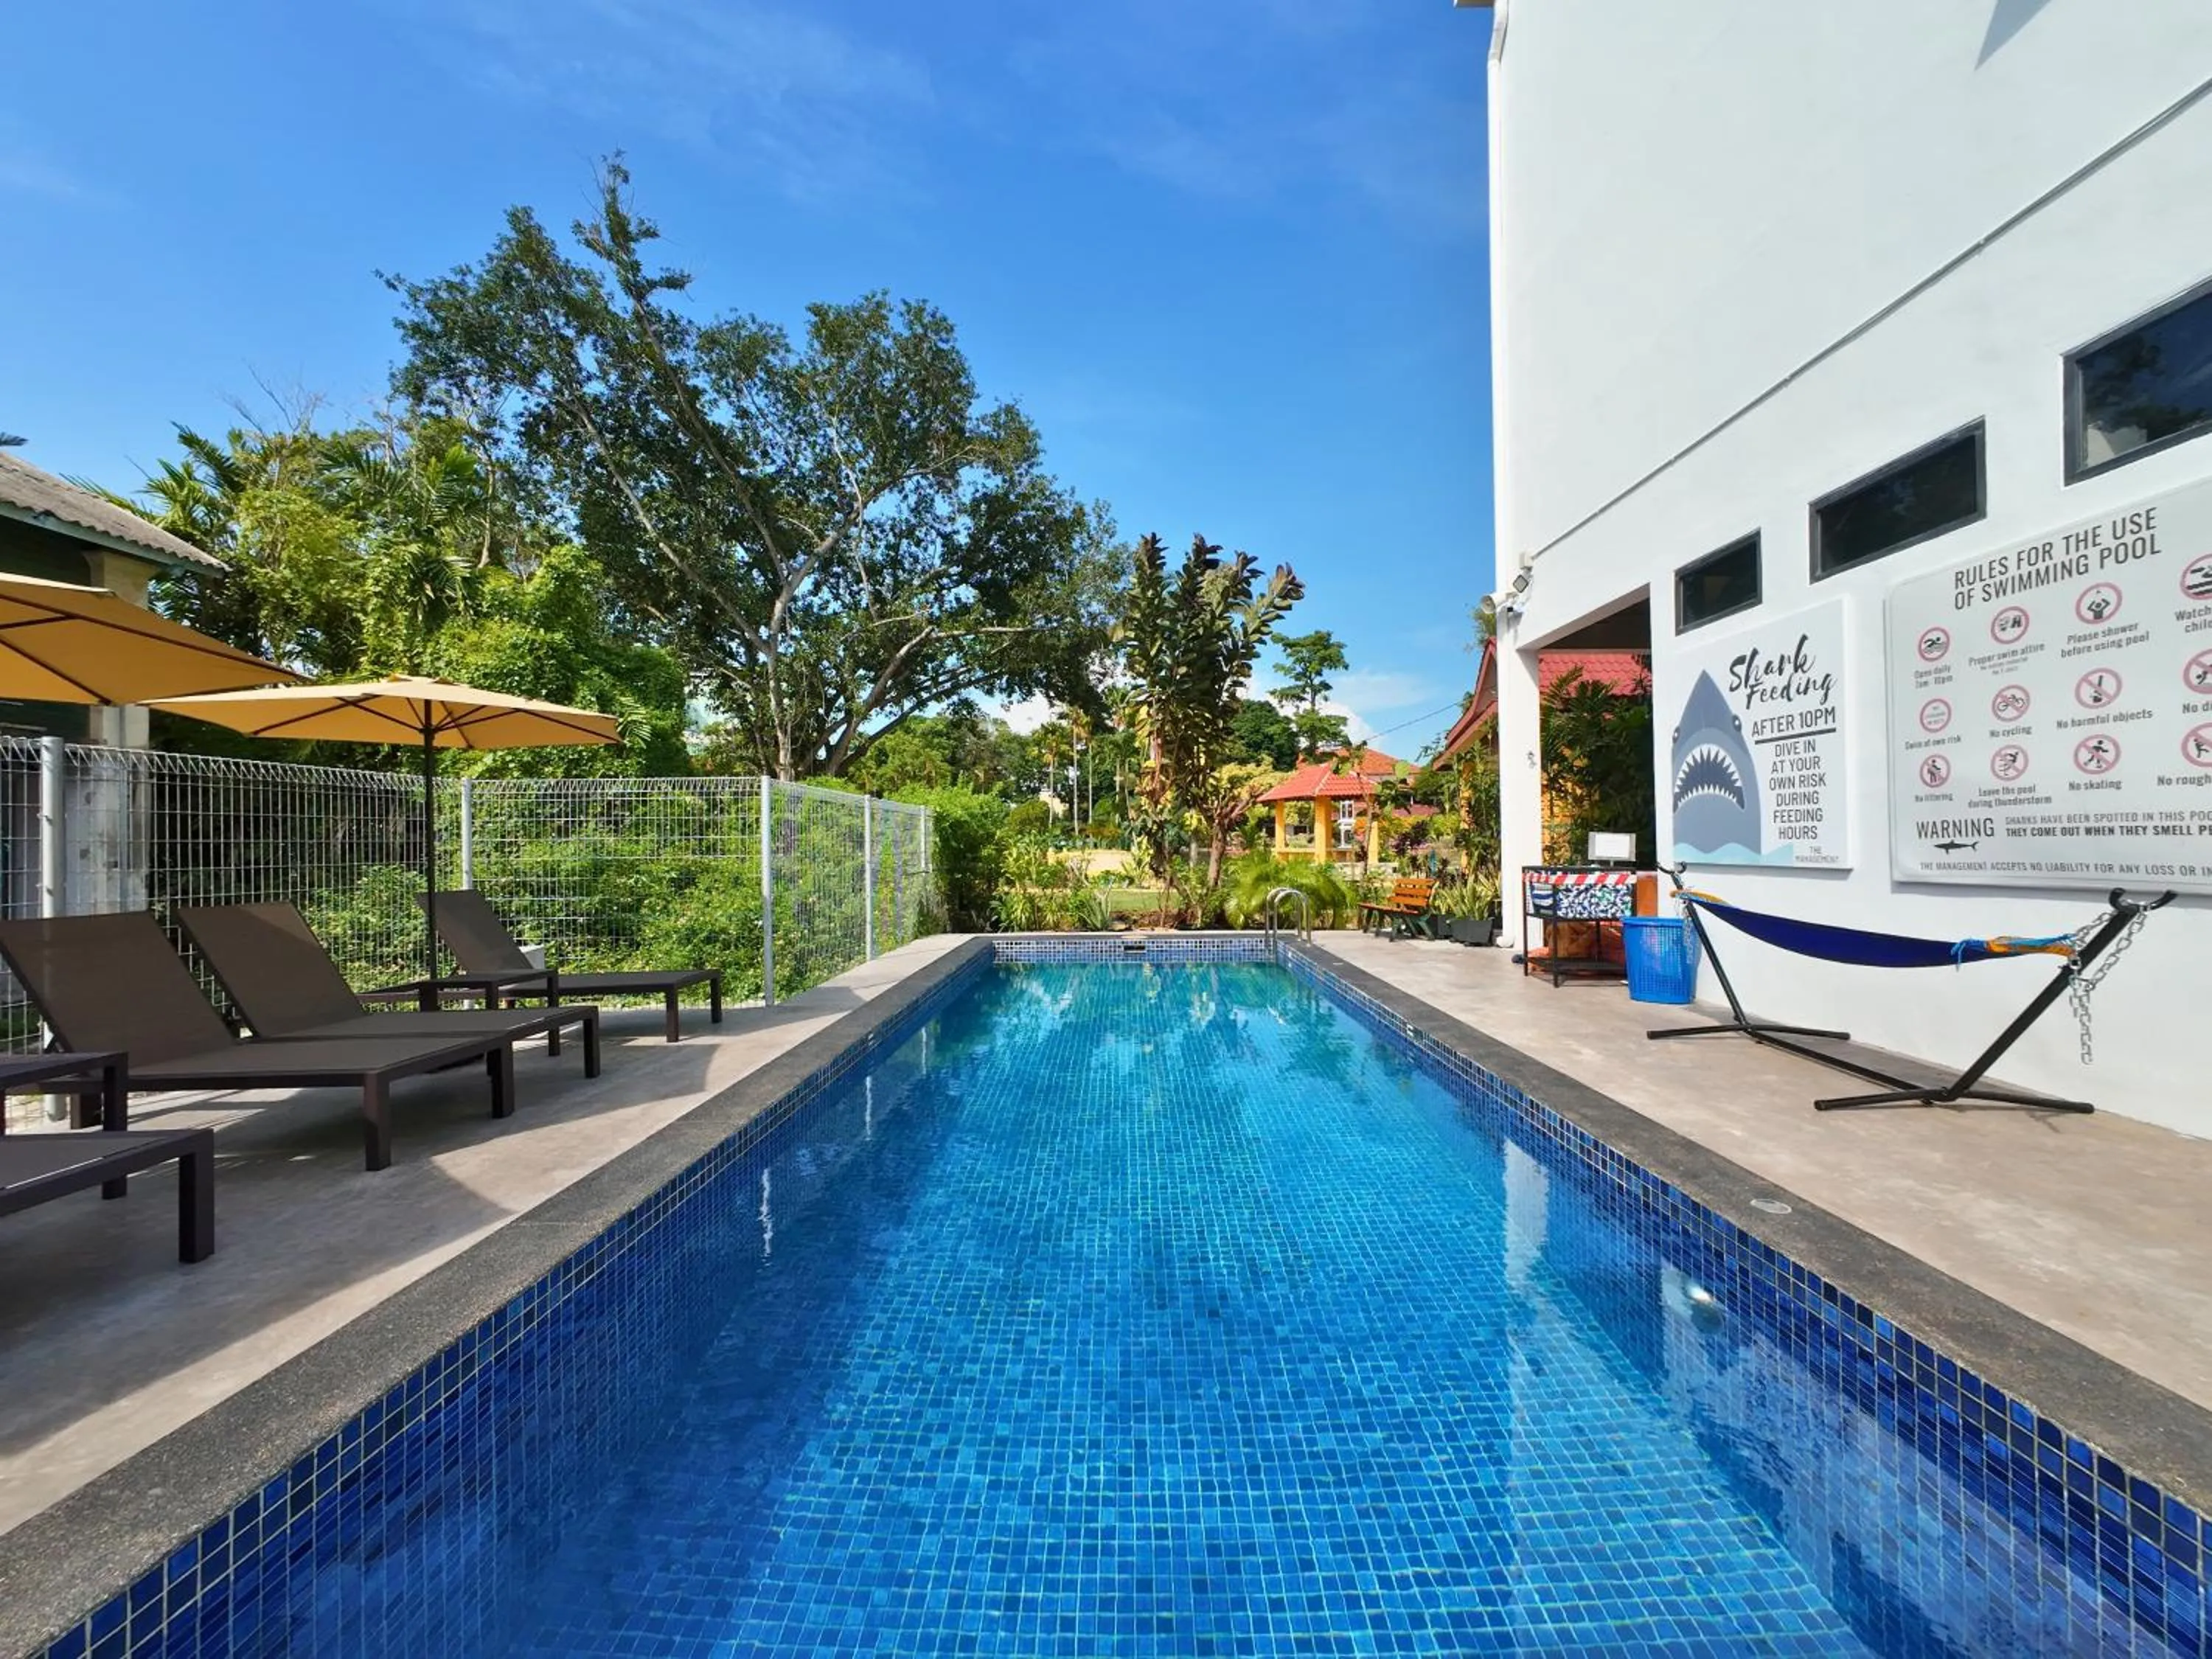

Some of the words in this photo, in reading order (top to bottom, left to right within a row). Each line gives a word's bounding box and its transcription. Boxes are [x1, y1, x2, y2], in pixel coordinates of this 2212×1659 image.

[1955, 556, 2008, 589] RULES
[2017, 542, 2053, 570] FOR
[2062, 525, 2101, 556] THE
[2112, 507, 2157, 540] USE
[1955, 587, 1975, 610] OF
[1982, 554, 2089, 602] SWIMMING
[2100, 533, 2161, 569] POOL
[2174, 605, 2211, 622] Watch
[2067, 632, 2099, 644] Please
[2101, 622, 2138, 637] shower
[2061, 644, 2092, 658] before
[2095, 639, 2123, 651] using
[2126, 630, 2149, 647] pool
[1729, 633, 1815, 692] Shark
[1968, 654, 1995, 667] Proper
[1997, 650, 2018, 661] swim
[1746, 673, 1837, 709] Feeding
[2183, 703, 2198, 714] No
[1752, 714, 1794, 737] AFTER
[1799, 706, 1834, 728] 10PM
[2056, 720, 2068, 729] No
[2071, 714, 2110, 726] harmful
[2112, 709, 2153, 723] objects
[1989, 729, 2000, 737] No
[2002, 726, 2032, 737] cycling
[1775, 741, 1800, 757] DIVE
[1804, 739, 1815, 753] IN
[1771, 760, 1784, 773] AT
[1790, 756, 1820, 772] YOUR
[1769, 775, 1795, 790] OWN
[1799, 773, 1826, 788] RISK
[2068, 781, 2081, 790] No
[2083, 779, 2124, 790] skating
[2157, 775, 2172, 786] No
[1776, 790, 1819, 807] DURING
[1978, 787, 2000, 797] Leave
[2002, 786, 2015, 795] the
[2017, 784, 2036, 795] pool
[1968, 799, 1993, 808] during
[1994, 796, 2053, 806] thunderstorm
[1773, 808, 1823, 824] FEEDING
[2040, 815, 2064, 824] HAVE
[2067, 813, 2090, 824] BEEN
[2093, 812, 2138, 823] SPOTTED
[2142, 812, 2154, 822] IN
[2158, 811, 2185, 822] THIS
[1778, 825, 1818, 840] HOURS
[1917, 817, 1994, 839] WARNING
[2006, 827, 2028, 837] THEY
[2031, 827, 2057, 837] COME
[2061, 827, 2081, 837] OUT
[2084, 826, 2115, 835] WHEN
[2119, 825, 2149, 835] THEY
[2152, 825, 2193, 835] SMELL
[1809, 846, 1821, 854] THE
[1920, 862, 1933, 871] THE
[1991, 861, 2027, 872] ACCEPTS
[2031, 863, 2043, 872] NO
[2045, 862, 2090, 872] LIABILITY
[2094, 863, 2115, 873] FOR
[2118, 864, 2140, 874] ANY
[2145, 865, 2175, 876] LOSS
[2179, 865, 2197, 877] OR
